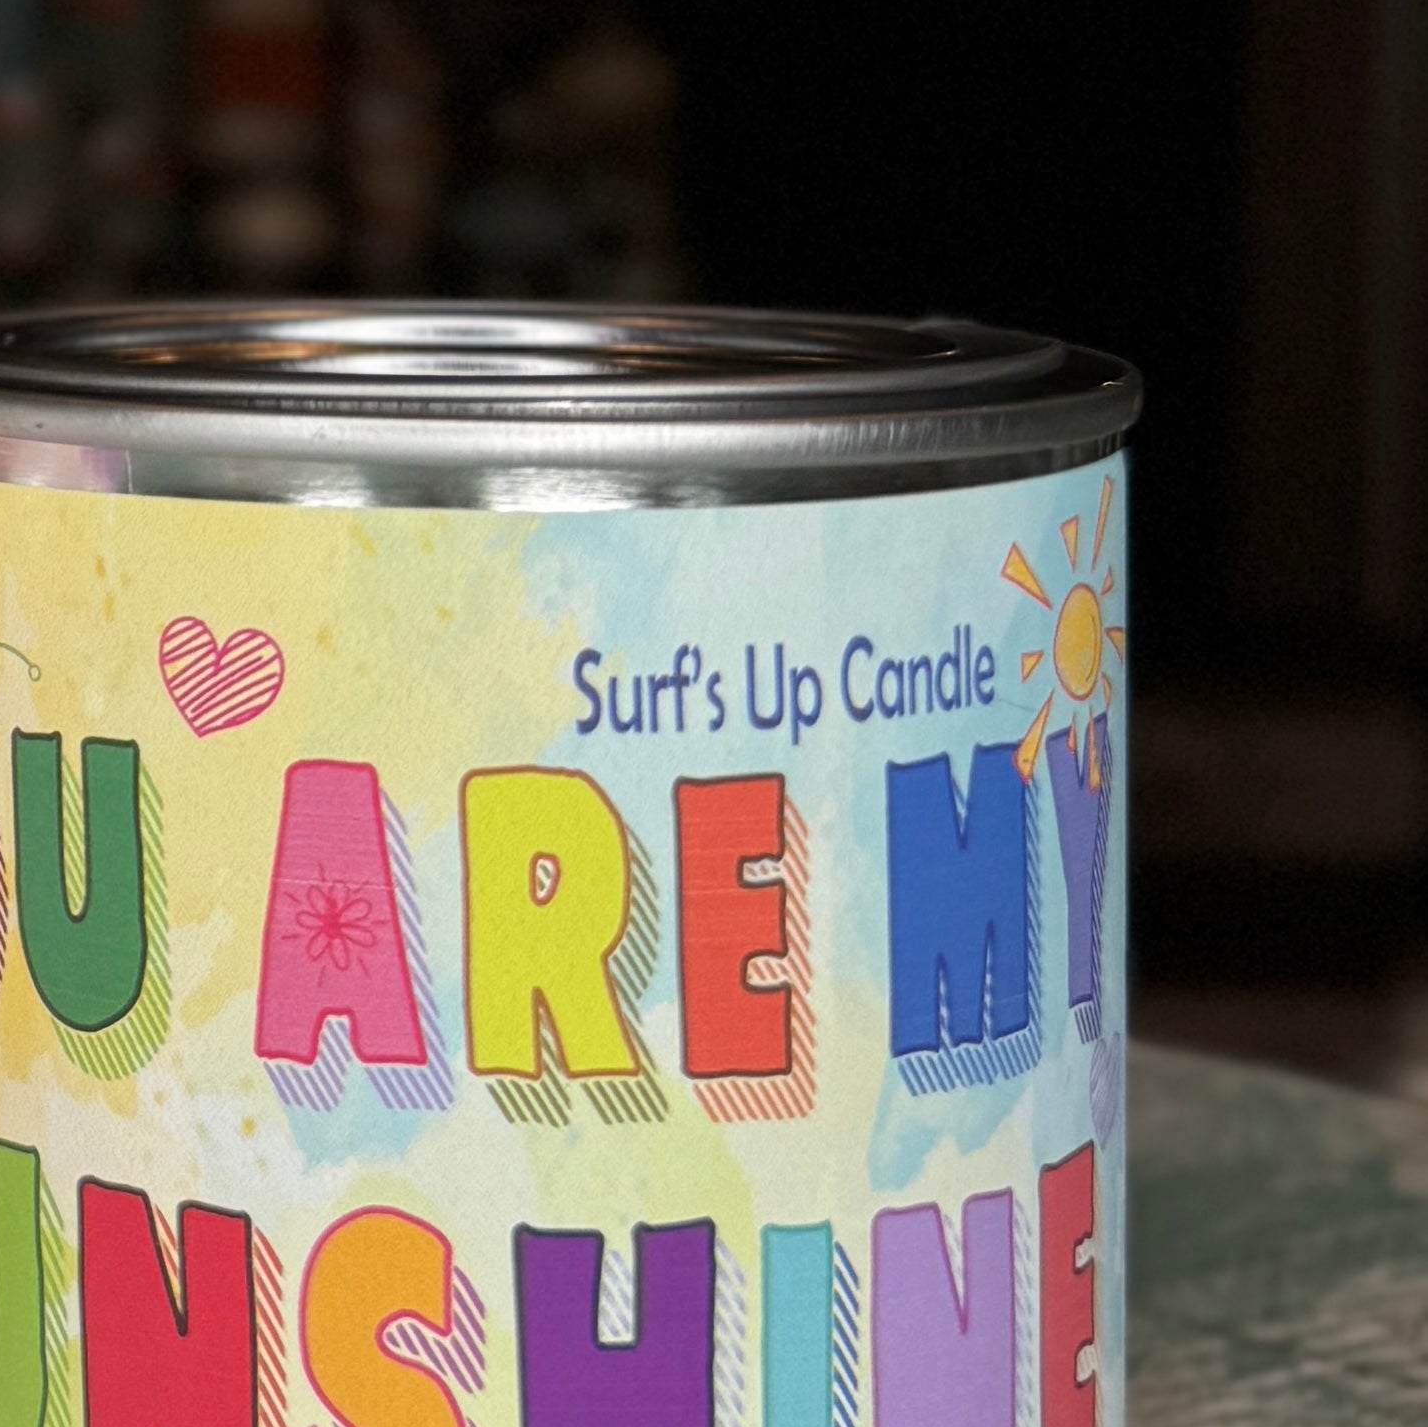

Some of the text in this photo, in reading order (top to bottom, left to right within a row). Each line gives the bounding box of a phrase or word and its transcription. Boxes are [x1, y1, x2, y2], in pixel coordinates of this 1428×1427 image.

[572, 623, 996, 746] Surf's Up Candle
[253, 758, 817, 1127] ARE
[884, 712, 1114, 1098] MY
